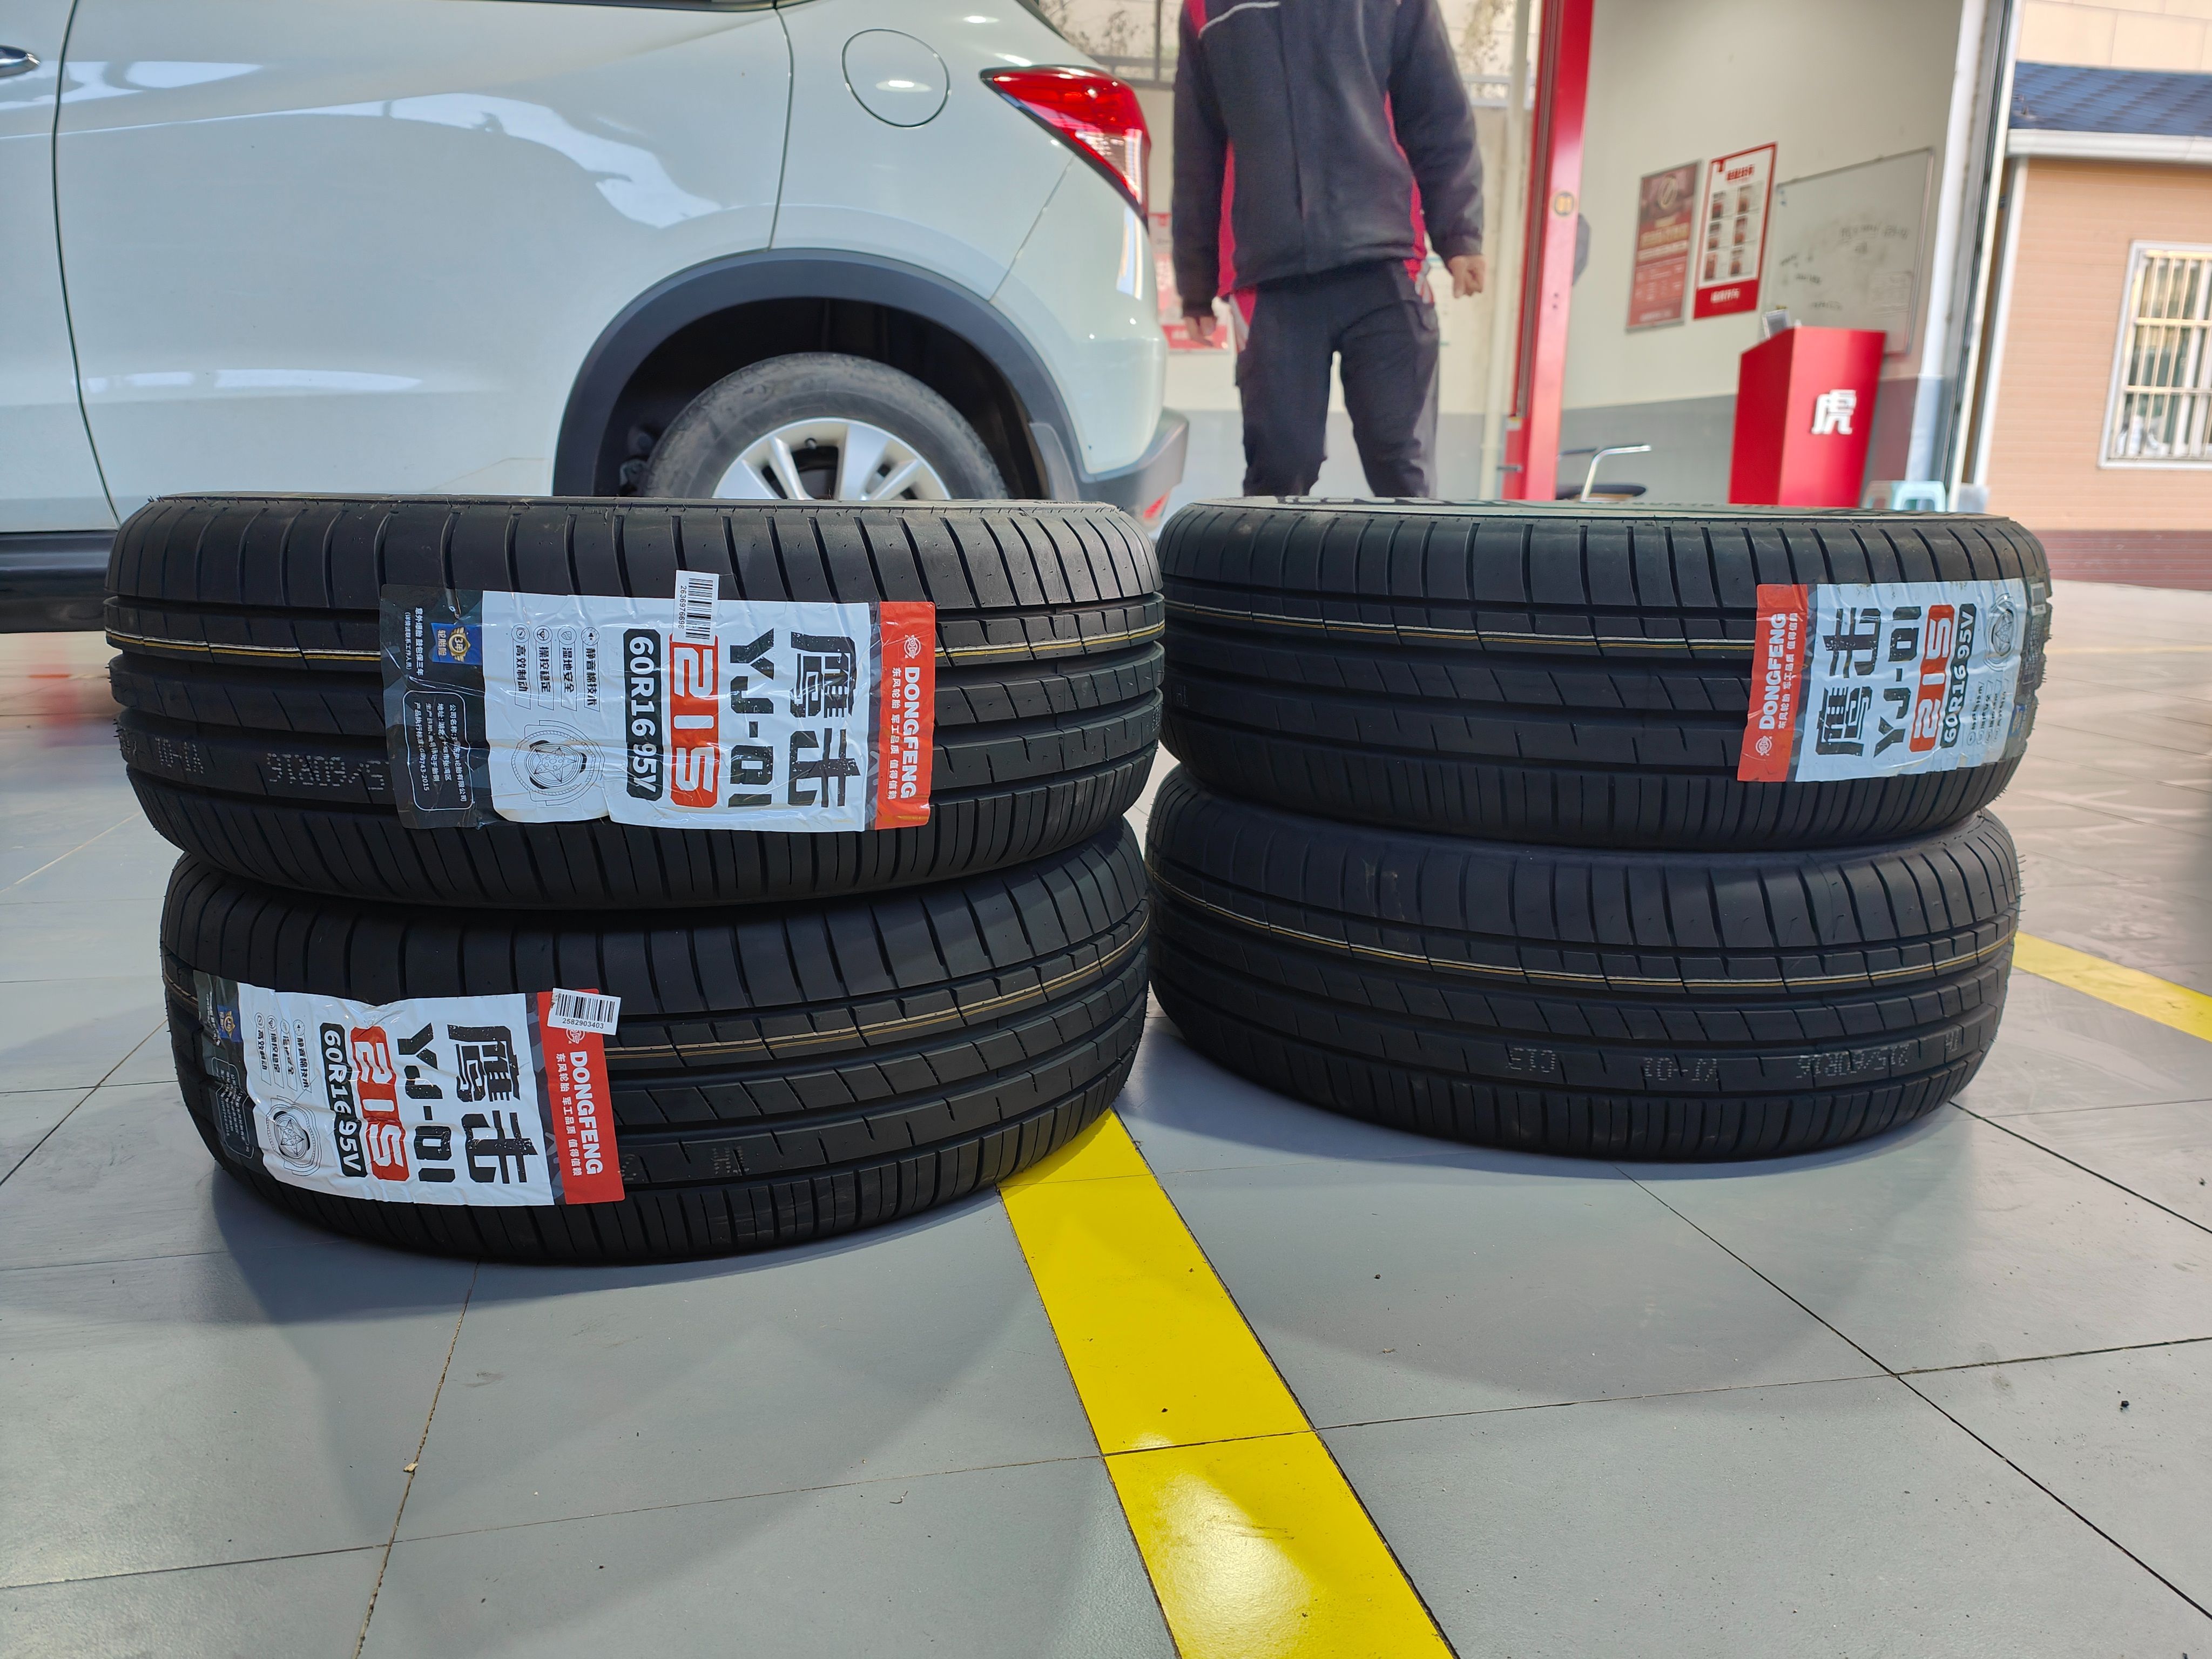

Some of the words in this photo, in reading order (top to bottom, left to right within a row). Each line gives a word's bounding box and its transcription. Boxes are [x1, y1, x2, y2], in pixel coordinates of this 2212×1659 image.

[1811, 388, 1857, 435] 虎
[415, 606, 424, 637] 意外爆胎
[678, 585, 687, 630] 2636976698
[415, 638, 424, 677] 鼓包保三年
[437, 629, 447, 656] 轮胎险
[453, 637, 463, 652] 3年
[515, 644, 529, 692] 高效制动
[539, 646, 551, 693] 操控稳定
[561, 647, 575, 693] 湿地安全
[585, 647, 598, 706] 静音棉技术
[629, 636, 656, 738] 60R16
[892, 666, 901, 709] 东风轮胎
[1758, 612, 1786, 730] DONGFENG
[1783, 653, 1794, 690] 军工品质
[1815, 606, 1881, 757] 鹰击
[1920, 617, 1952, 739] 215
[1944, 665, 1967, 741] 60R16
[1957, 611, 1975, 662] 95V
[673, 647, 715, 793] 215
[787, 631, 861, 808] 鹰击
[890, 713, 900, 755] 军工品质
[899, 666, 921, 799] DONGFENG
[1778, 693, 1790, 730] 东风轮胎
[632, 743, 657, 794] 95V
[888, 759, 899, 800] 值得信赖
[562, 1017, 604, 1029] 2582903403
[556, 1053, 570, 1092] 东风轮胎
[323, 1029, 351, 1114] 60R16
[338, 1119, 361, 1171] 95V
[354, 1041, 404, 1168] 215
[447, 1024, 538, 1184] 鹰击
[561, 1097, 576, 1136] 军工品质
[569, 1051, 603, 1175] DONGFENG
[567, 1138, 583, 1177] 值得信赖
